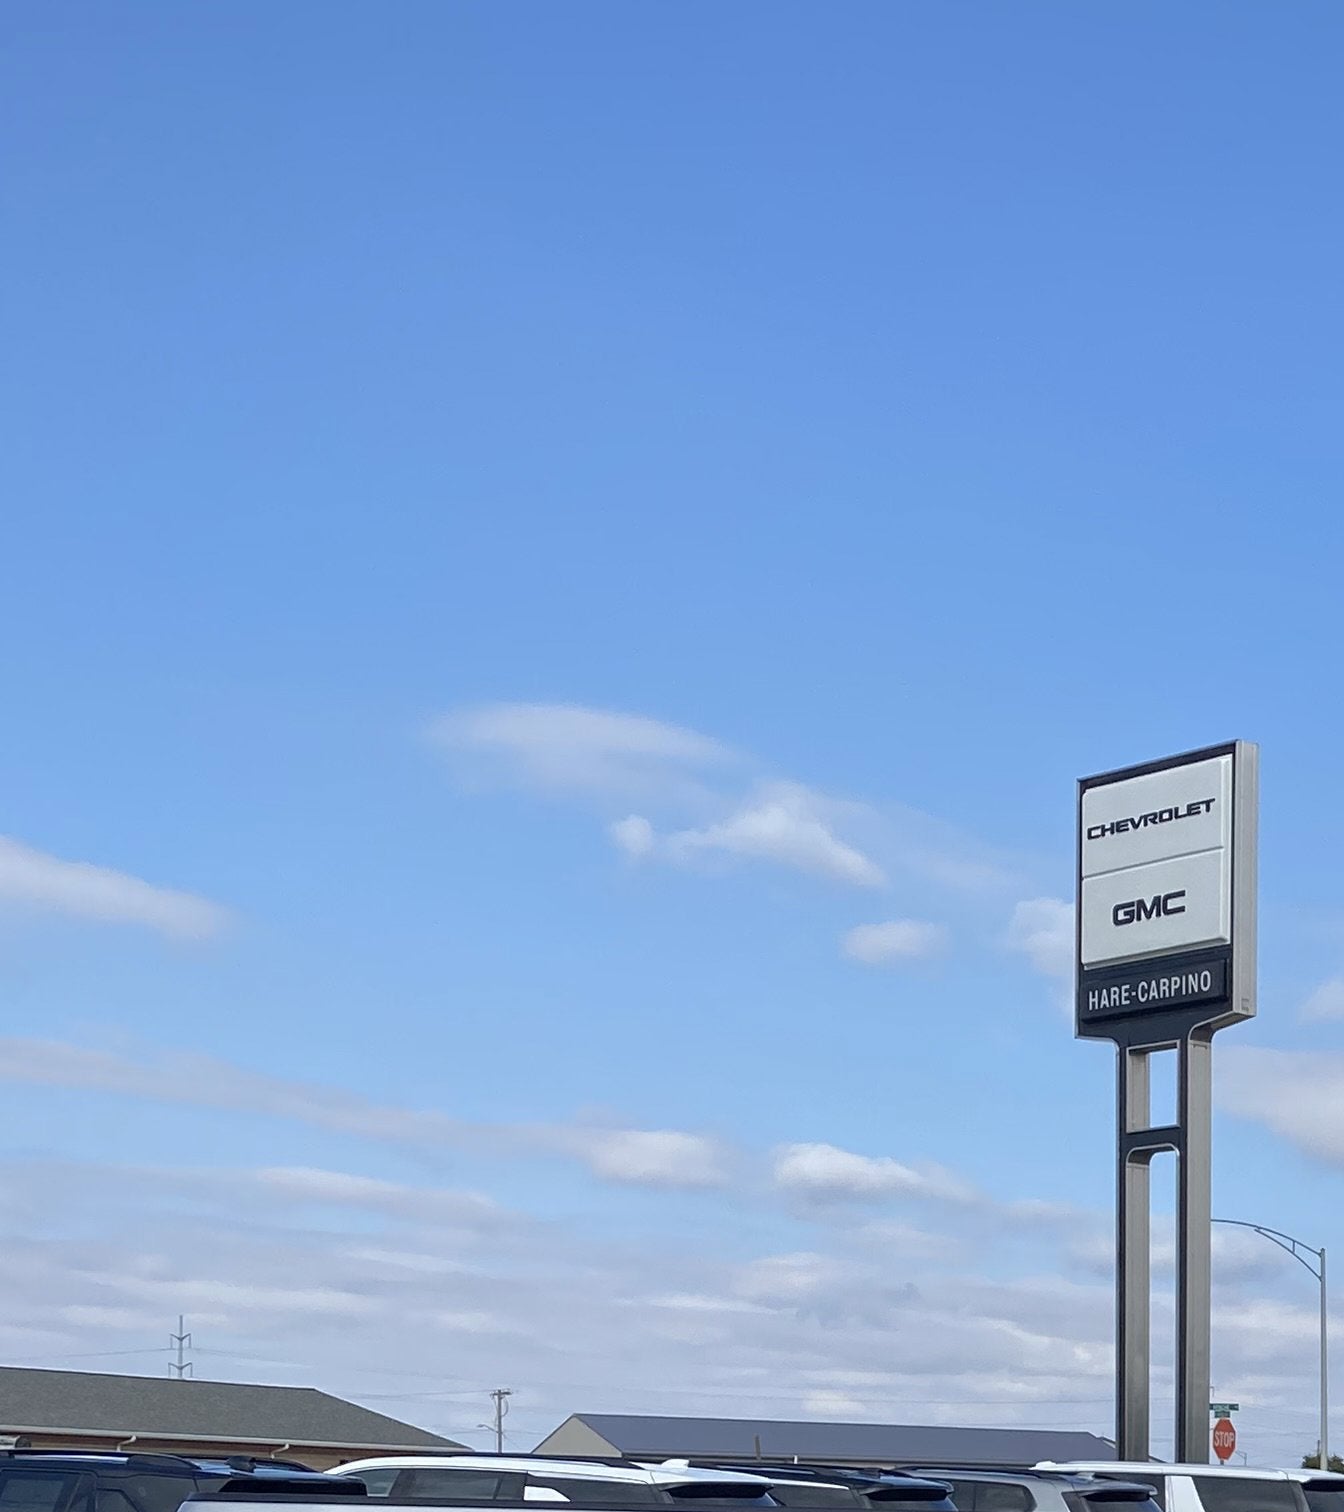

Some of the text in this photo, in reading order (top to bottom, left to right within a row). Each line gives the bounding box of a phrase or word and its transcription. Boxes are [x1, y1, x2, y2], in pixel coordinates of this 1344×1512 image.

[1087, 798, 1216, 840] CHEVROLET
[1112, 890, 1187, 926] GMC
[1088, 970, 1212, 1011] HARE-CARPINO
[1214, 1431, 1235, 1448] STOP
